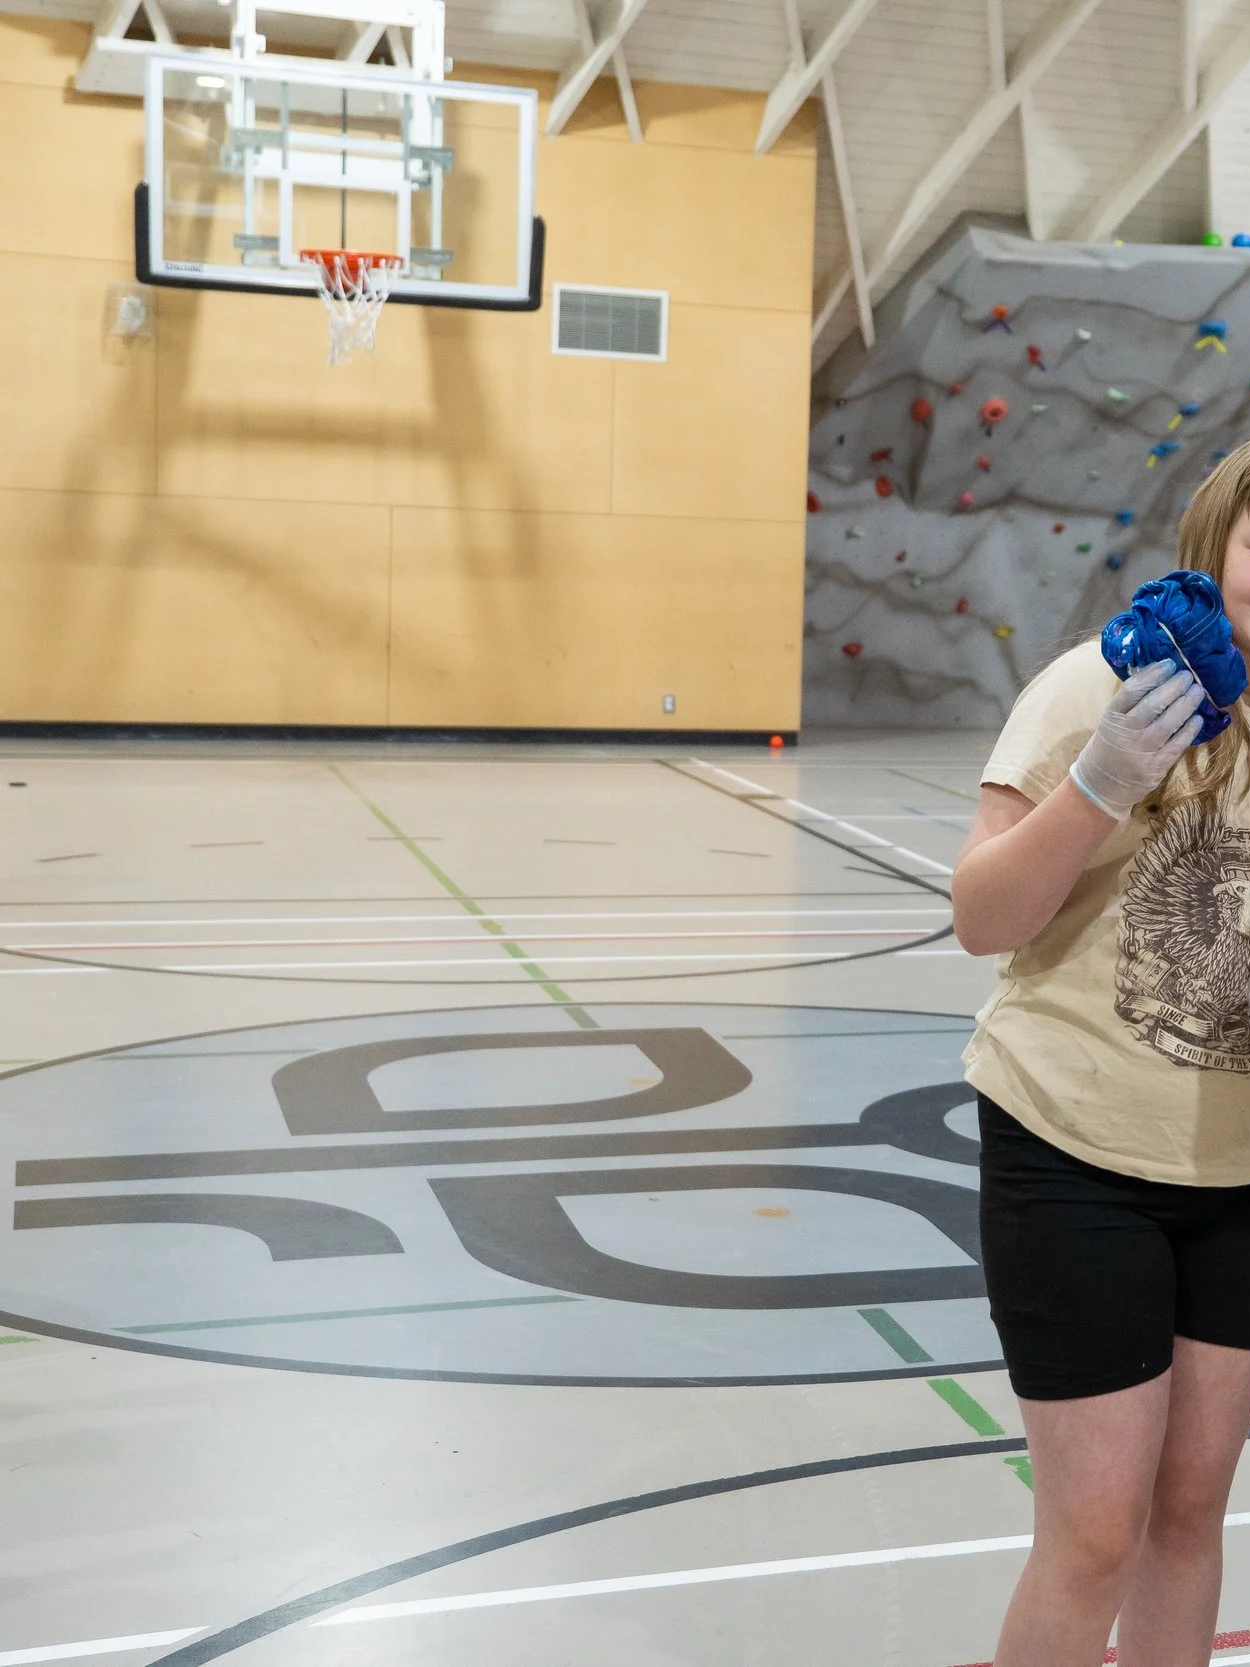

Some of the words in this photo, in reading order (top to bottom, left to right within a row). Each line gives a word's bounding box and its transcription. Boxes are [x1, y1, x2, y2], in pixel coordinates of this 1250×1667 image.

[1157, 1004, 1188, 1027] SINCE
[1174, 1043, 1213, 1065] SPIRIT
[1213, 1055, 1228, 1068] OF
[1228, 1057, 1249, 1070] THE
